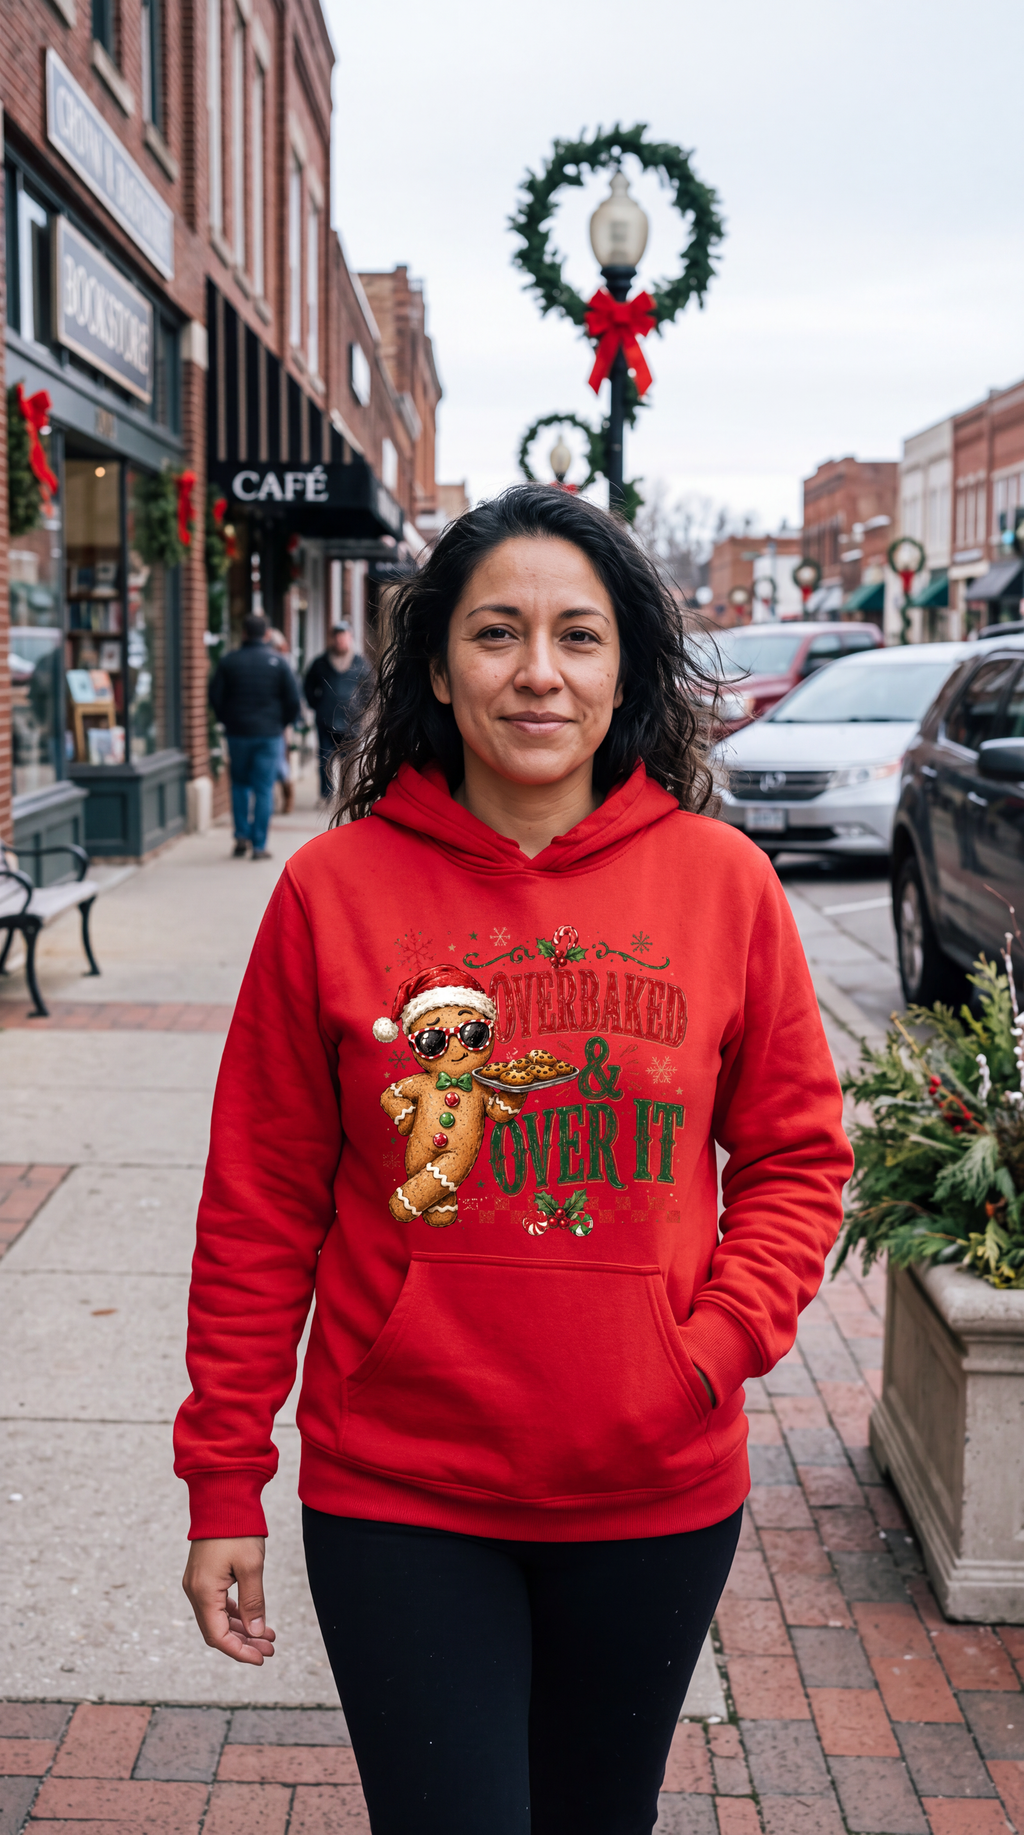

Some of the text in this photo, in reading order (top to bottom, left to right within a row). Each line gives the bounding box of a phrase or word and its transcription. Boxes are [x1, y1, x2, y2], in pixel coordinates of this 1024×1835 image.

[64, 254, 149, 375] BOOKSTORE
[232, 465, 329, 502] CAFÉ
[490, 969, 688, 1048] OVERBAKED
[578, 1036, 624, 1101] &
[490, 1098, 685, 1197] OVER IT
